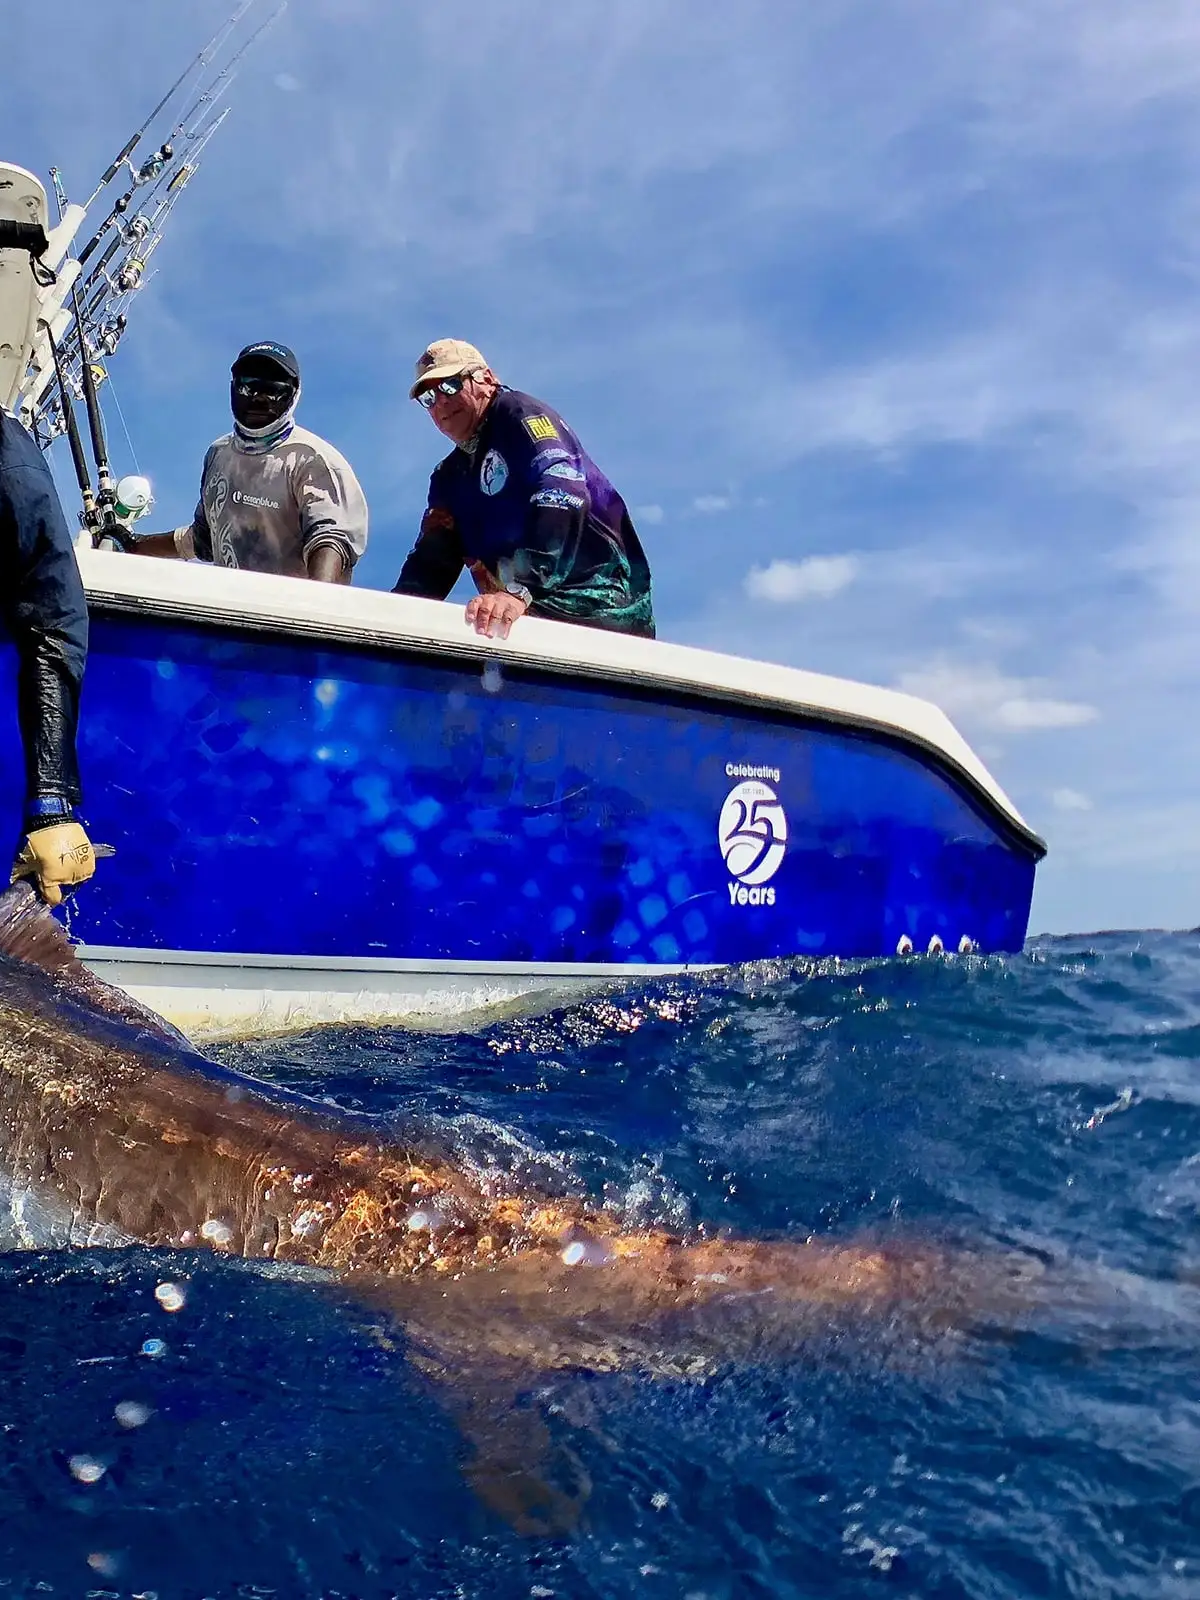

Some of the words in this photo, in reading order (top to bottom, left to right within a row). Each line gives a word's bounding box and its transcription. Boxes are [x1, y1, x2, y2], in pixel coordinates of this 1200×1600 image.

[725, 763, 780, 782] Celebrating
[725, 799, 786, 877] 25
[728, 882, 776, 905] Years
